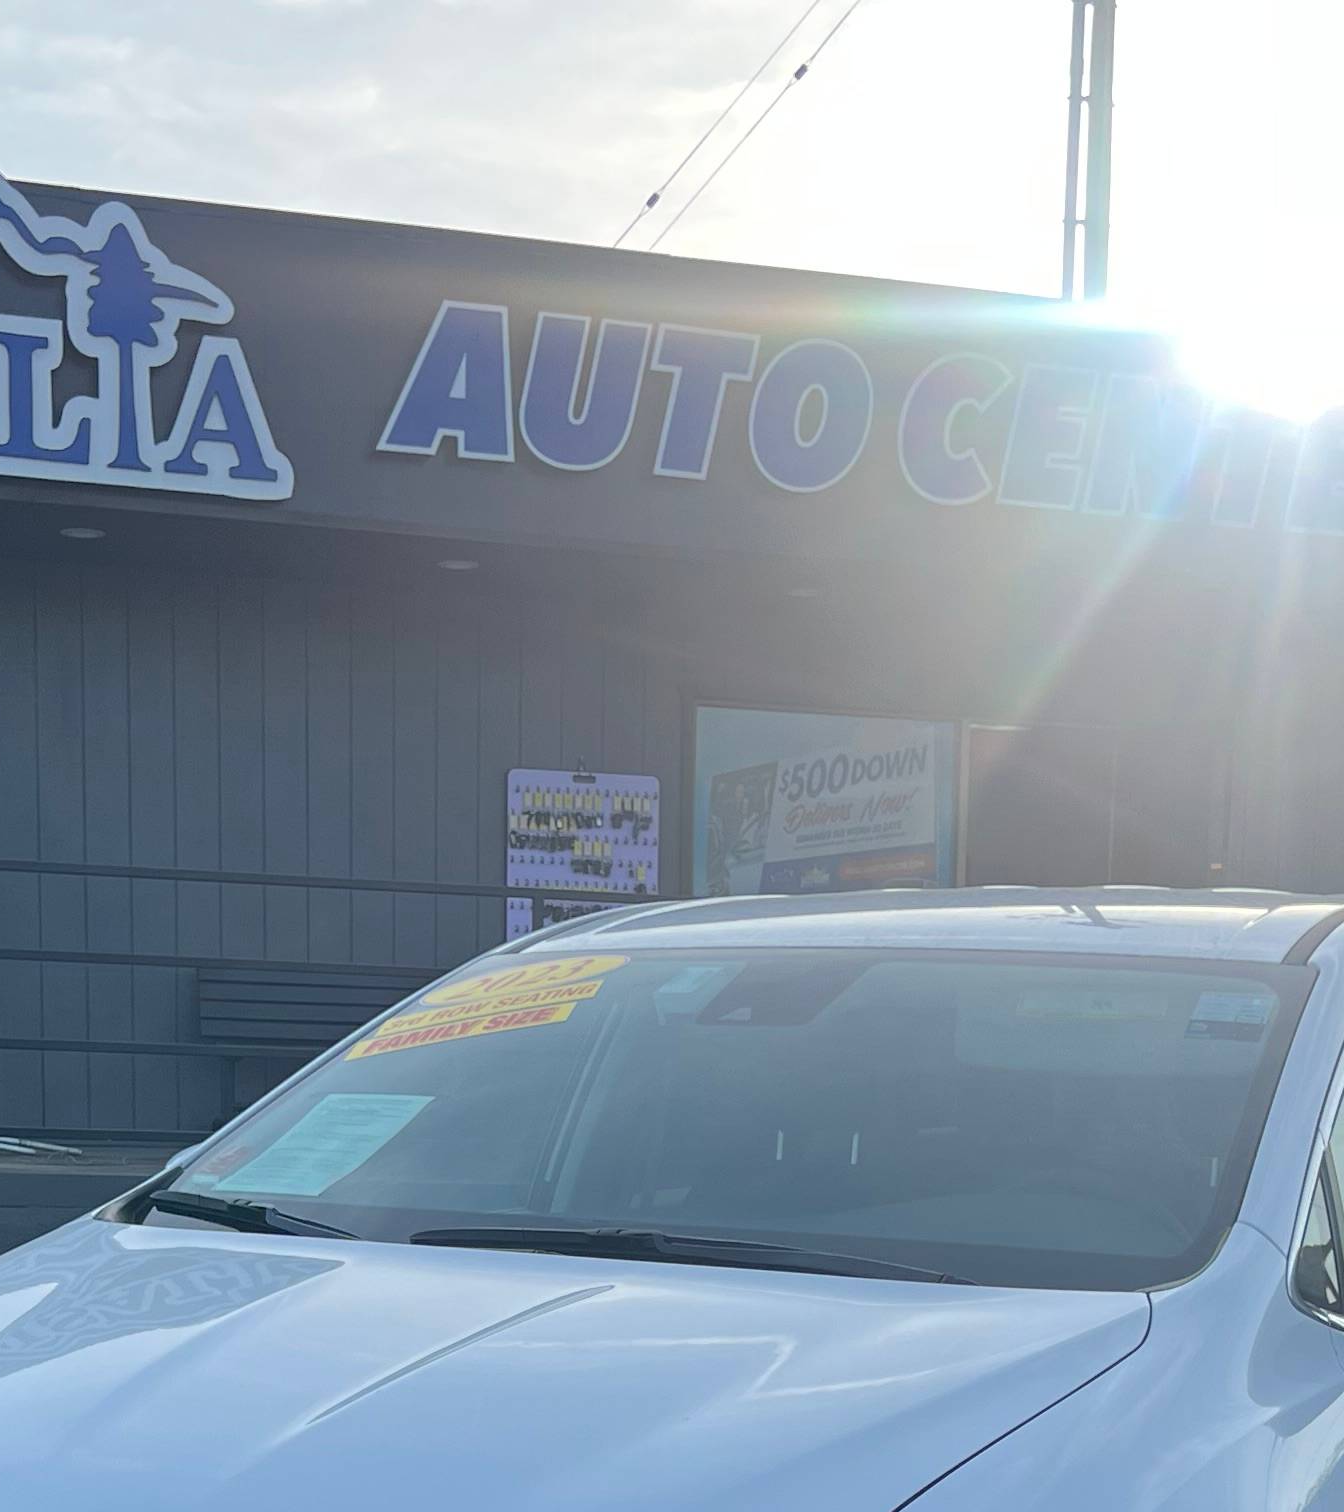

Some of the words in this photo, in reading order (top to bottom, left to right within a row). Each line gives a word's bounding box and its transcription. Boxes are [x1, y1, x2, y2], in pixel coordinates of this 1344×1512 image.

[376, 299, 873, 493] AUTO
[778, 753, 849, 801] $500
[850, 744, 928, 785] DOWN
[430, 1000, 491, 1021] ROW
[494, 981, 601, 1008] SEATING
[449, 957, 595, 1000] 2023
[360, 1018, 479, 1056] FAMILY
[481, 1006, 561, 1031] SIZE
